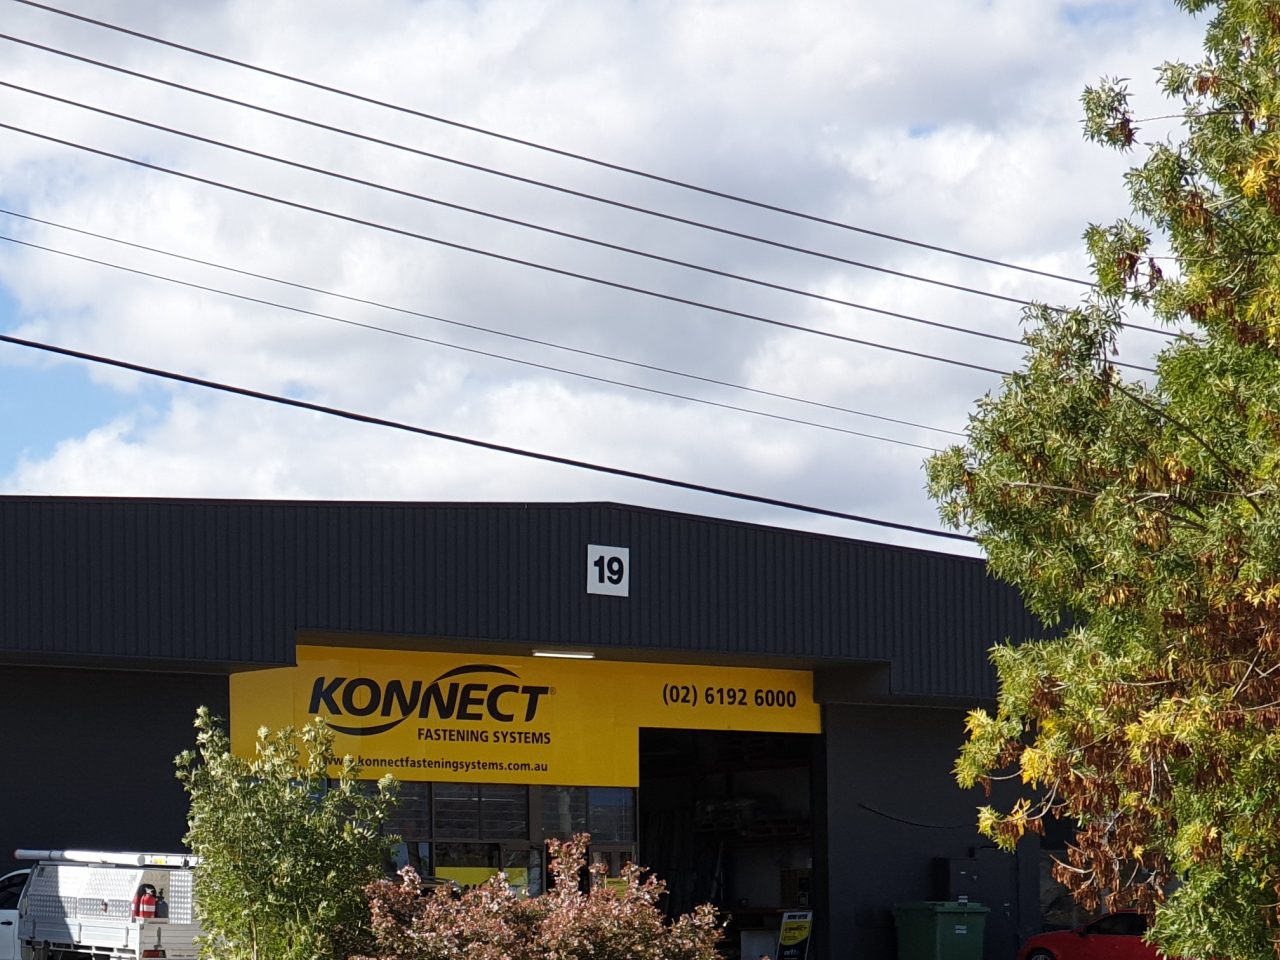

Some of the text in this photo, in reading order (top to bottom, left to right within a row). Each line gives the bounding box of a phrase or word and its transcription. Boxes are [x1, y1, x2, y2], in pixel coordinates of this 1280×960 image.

[593, 555, 624, 585] 19
[308, 676, 549, 722] KONNECT
[663, 683, 797, 708] (02) 6192 6000
[417, 728, 551, 745] FASTENING SYSTEMS
[324, 755, 548, 772] wwkonnectfasteningsystems.com.au
